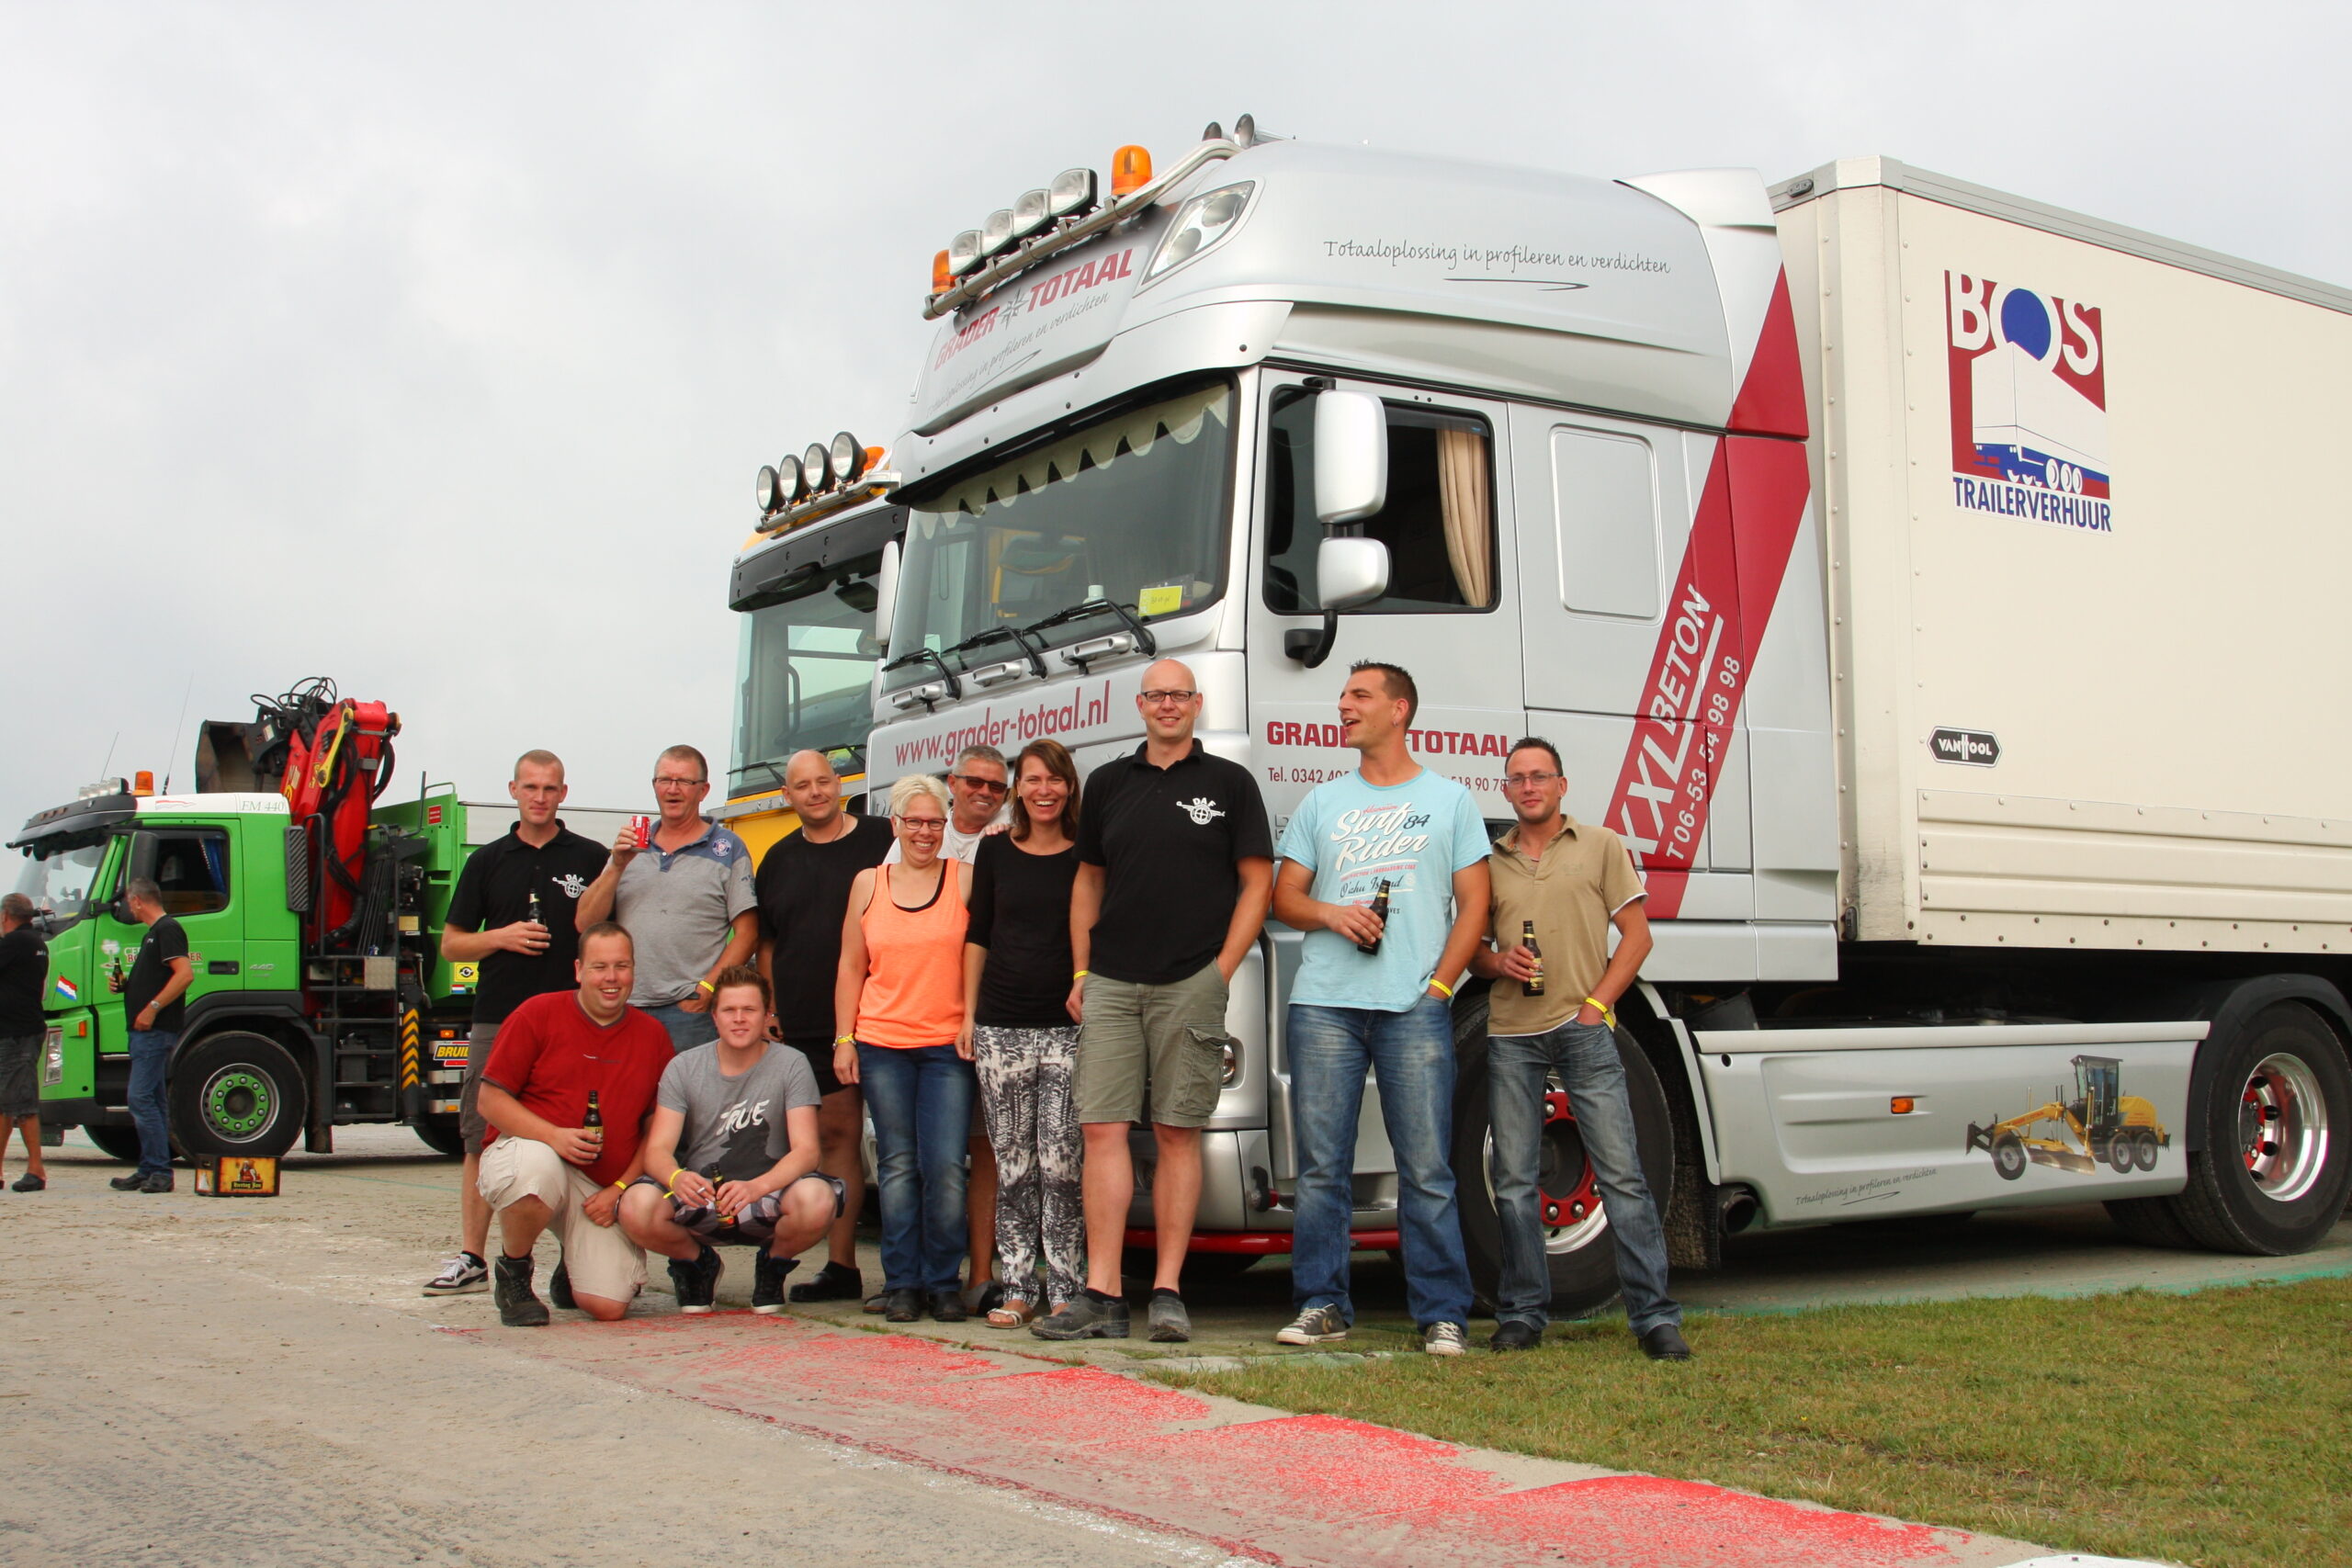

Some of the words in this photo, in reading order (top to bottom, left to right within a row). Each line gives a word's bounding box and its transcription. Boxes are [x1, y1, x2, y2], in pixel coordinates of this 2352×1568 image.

[1323, 238, 1458, 271] Totaaloplossing
[1463, 243, 1483, 262] in
[1486, 244, 1566, 274] profileren
[1567, 254, 1588, 268] en
[1590, 252, 1671, 274] verdichten
[934, 306, 1001, 371] GRADER
[1027, 248, 1134, 312] TOTAAL
[1049, 292, 1110, 330] verdichten
[1949, 269, 2100, 377] BOS
[1952, 476, 2112, 533] TRAILERVERHUUR
[1649, 582, 1711, 737] BETON
[1719, 655, 1741, 689] 98
[895, 679, 1111, 767] www.grader-totaal.nl
[1707, 693, 1730, 727] 98
[1698, 731, 1721, 763] 54
[1268, 766, 1287, 783] Tel.
[1291, 768, 1323, 784] 0342
[1475, 777, 1489, 791] 90
[1193, 797, 1216, 807] DAF
[1330, 802, 1416, 842] Surf
[1403, 814, 1430, 829] 84
[1334, 830, 1430, 872] Rider
[717, 1099, 770, 1134] TRUE
